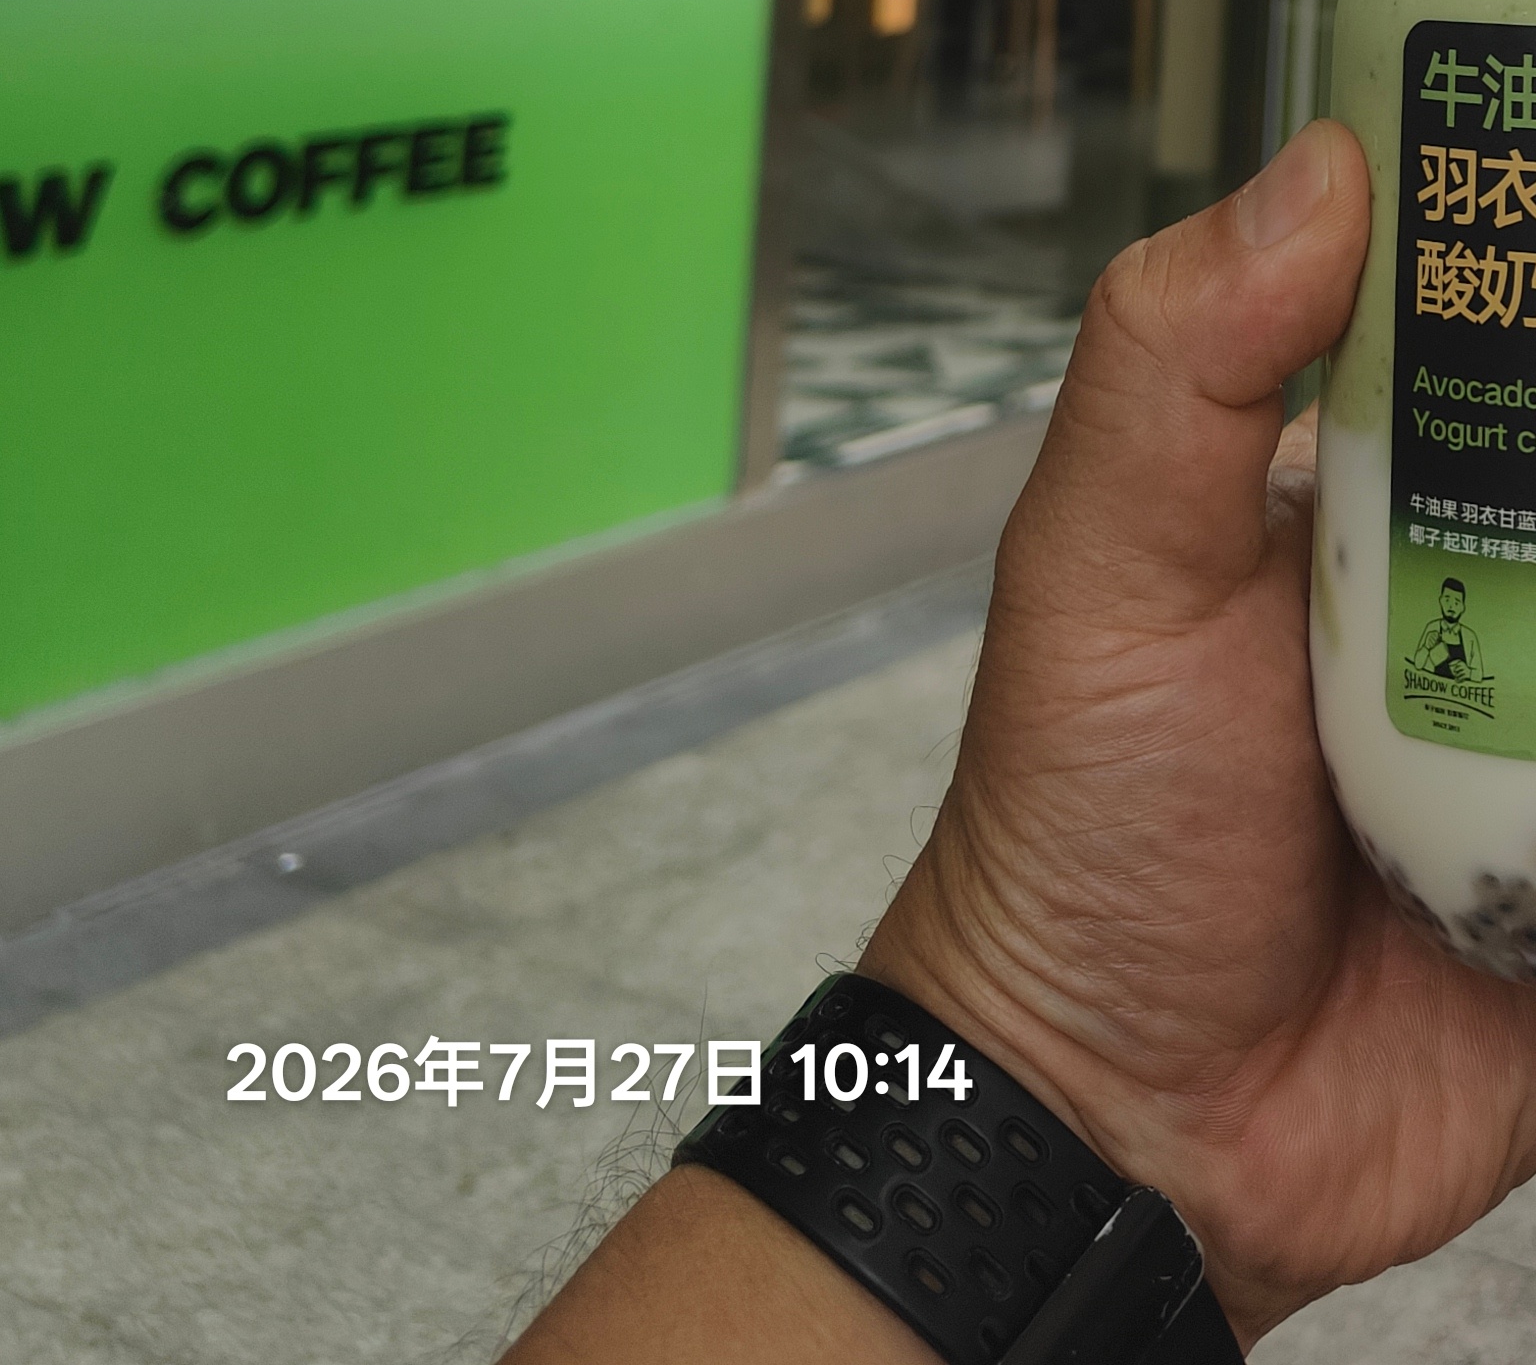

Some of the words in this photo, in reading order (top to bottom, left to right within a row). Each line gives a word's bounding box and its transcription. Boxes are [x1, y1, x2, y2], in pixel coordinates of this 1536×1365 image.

[156, 107, 513, 241] COFFEE
[1412, 407, 1508, 451] Yogurt
[1409, 492, 1459, 521] 牛油果
[1460, 503, 1536, 532] 羽衣甘蓝
[1404, 668, 1448, 694] SHADOW
[1450, 683, 1496, 709] COFFEE
